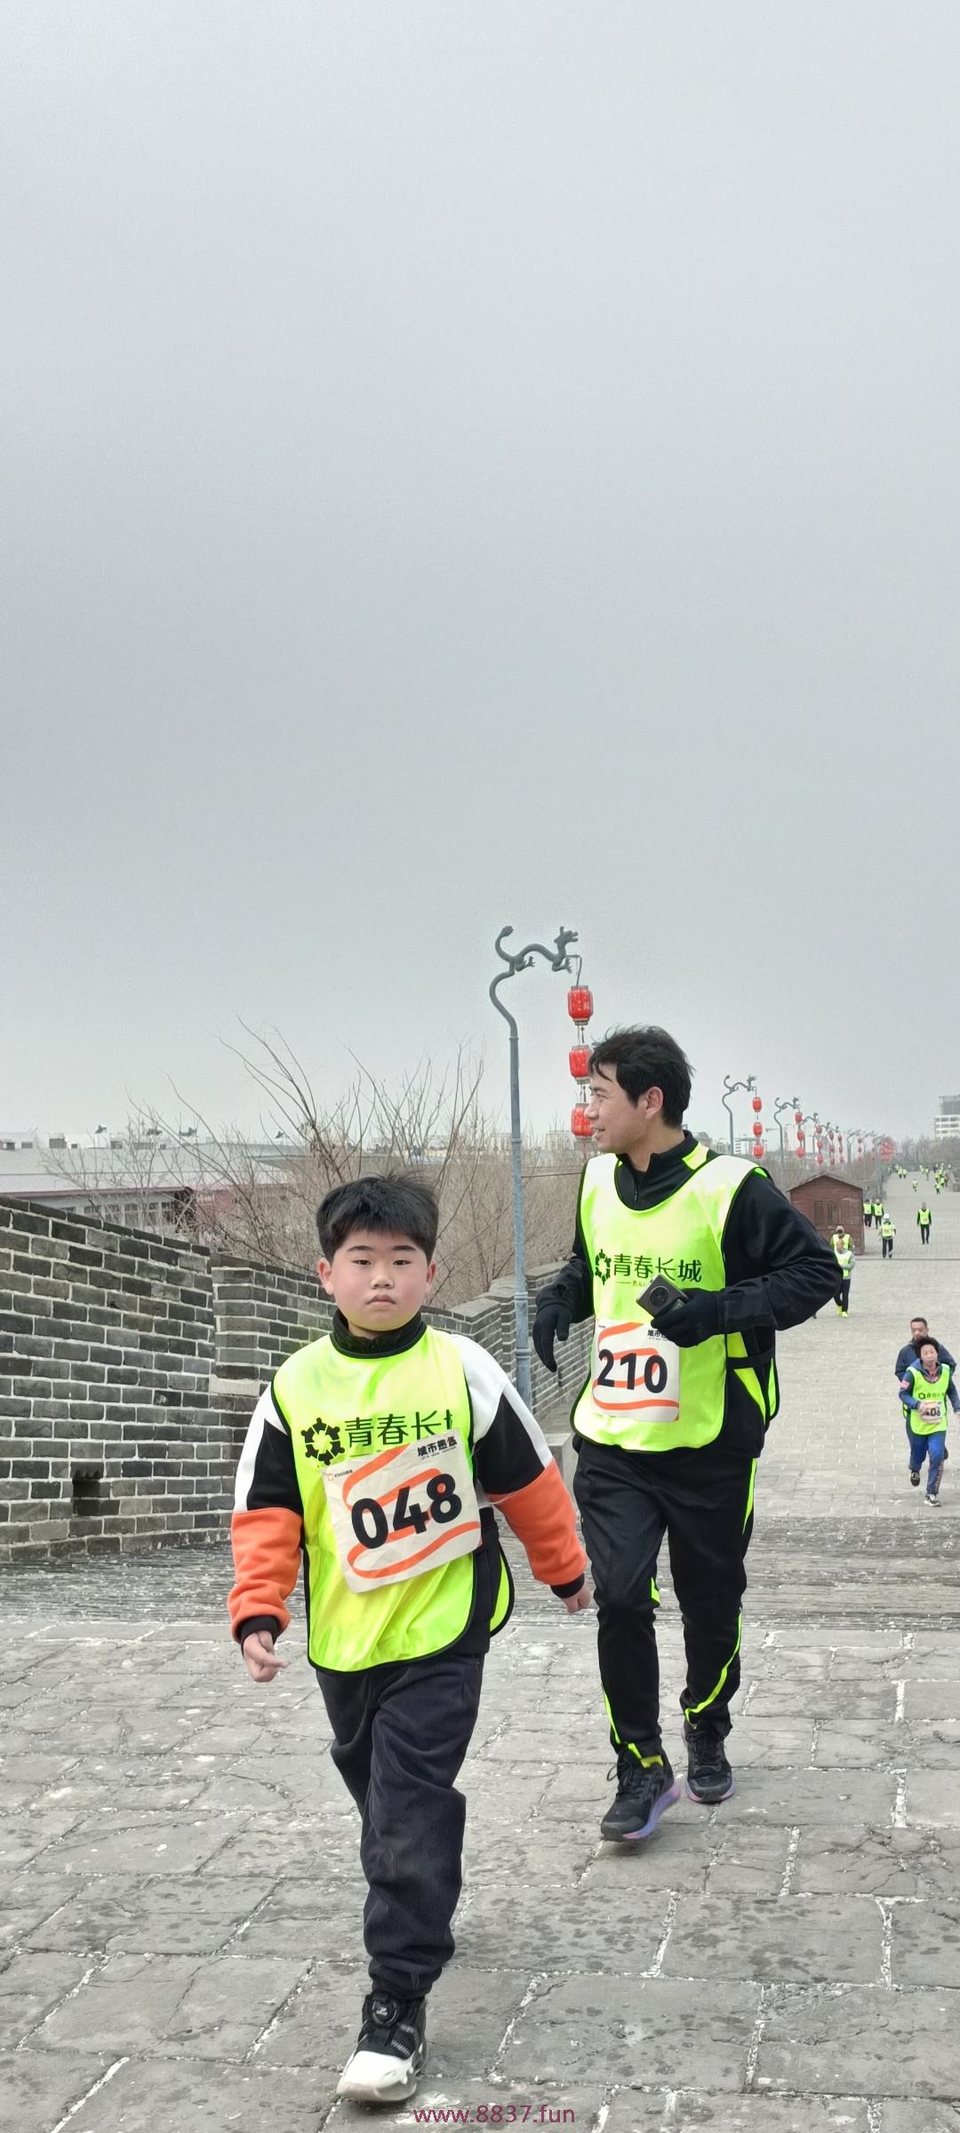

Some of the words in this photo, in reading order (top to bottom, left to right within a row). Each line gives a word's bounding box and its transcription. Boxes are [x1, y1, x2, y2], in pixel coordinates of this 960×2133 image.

[613, 1253, 702, 1284] 青春长城
[597, 1349, 668, 1393] 210
[351, 1474, 462, 1549] 048
